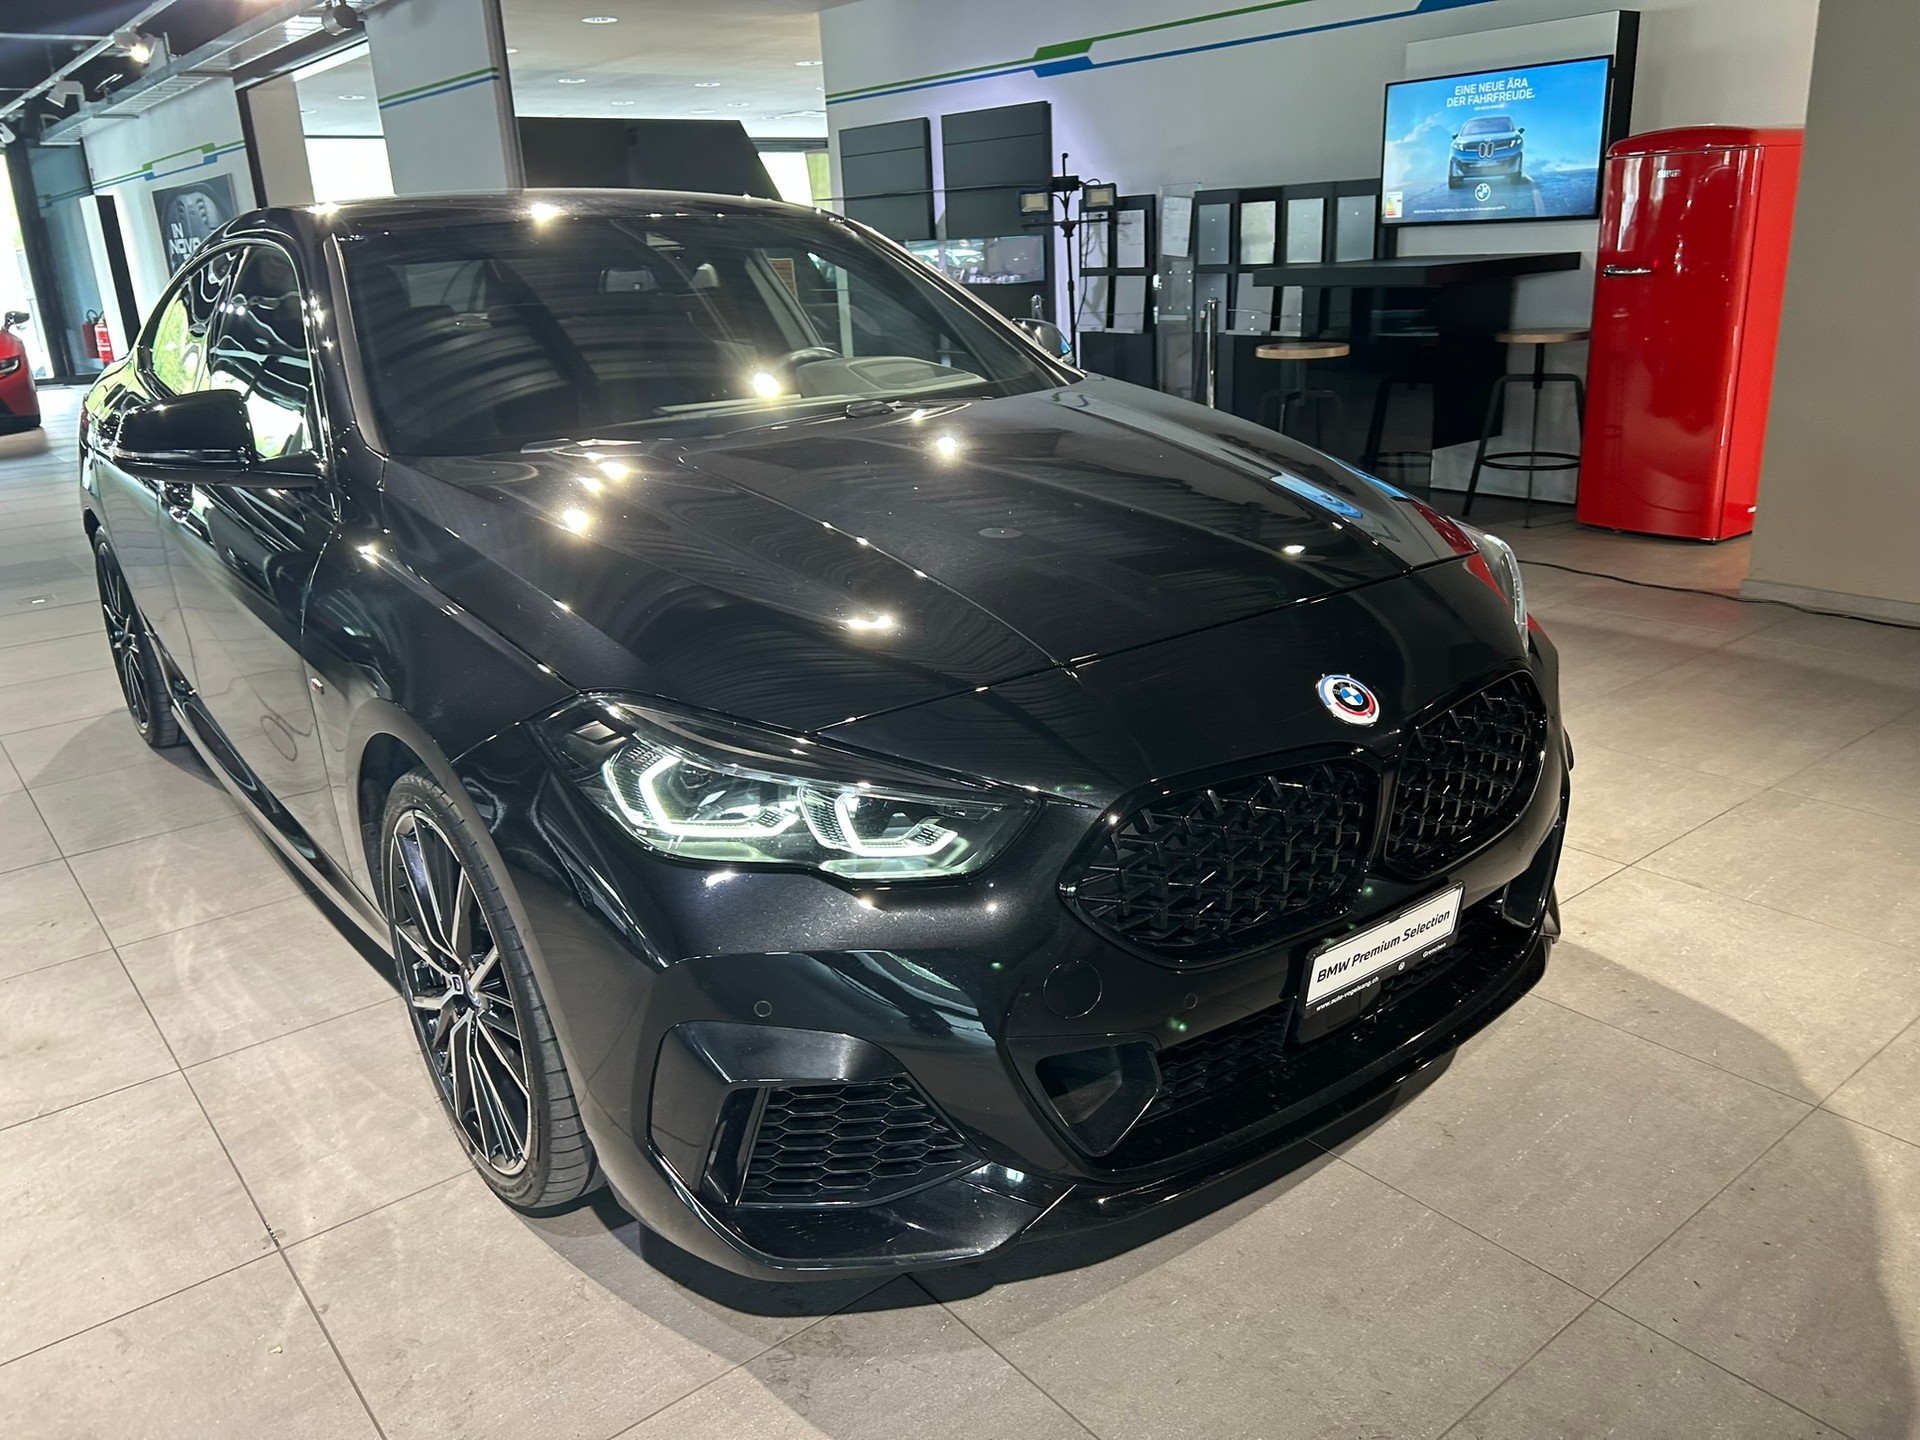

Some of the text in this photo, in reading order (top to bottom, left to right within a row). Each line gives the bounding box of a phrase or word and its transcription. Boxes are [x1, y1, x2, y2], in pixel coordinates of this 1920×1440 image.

[1455, 77, 1529, 96] EINE NEUE ÄRA
[1446, 95, 1467, 108] DER
[1467, 88, 1536, 106] FAHRFREUDE.
[1317, 909, 1451, 984] BMW Premium Selection
